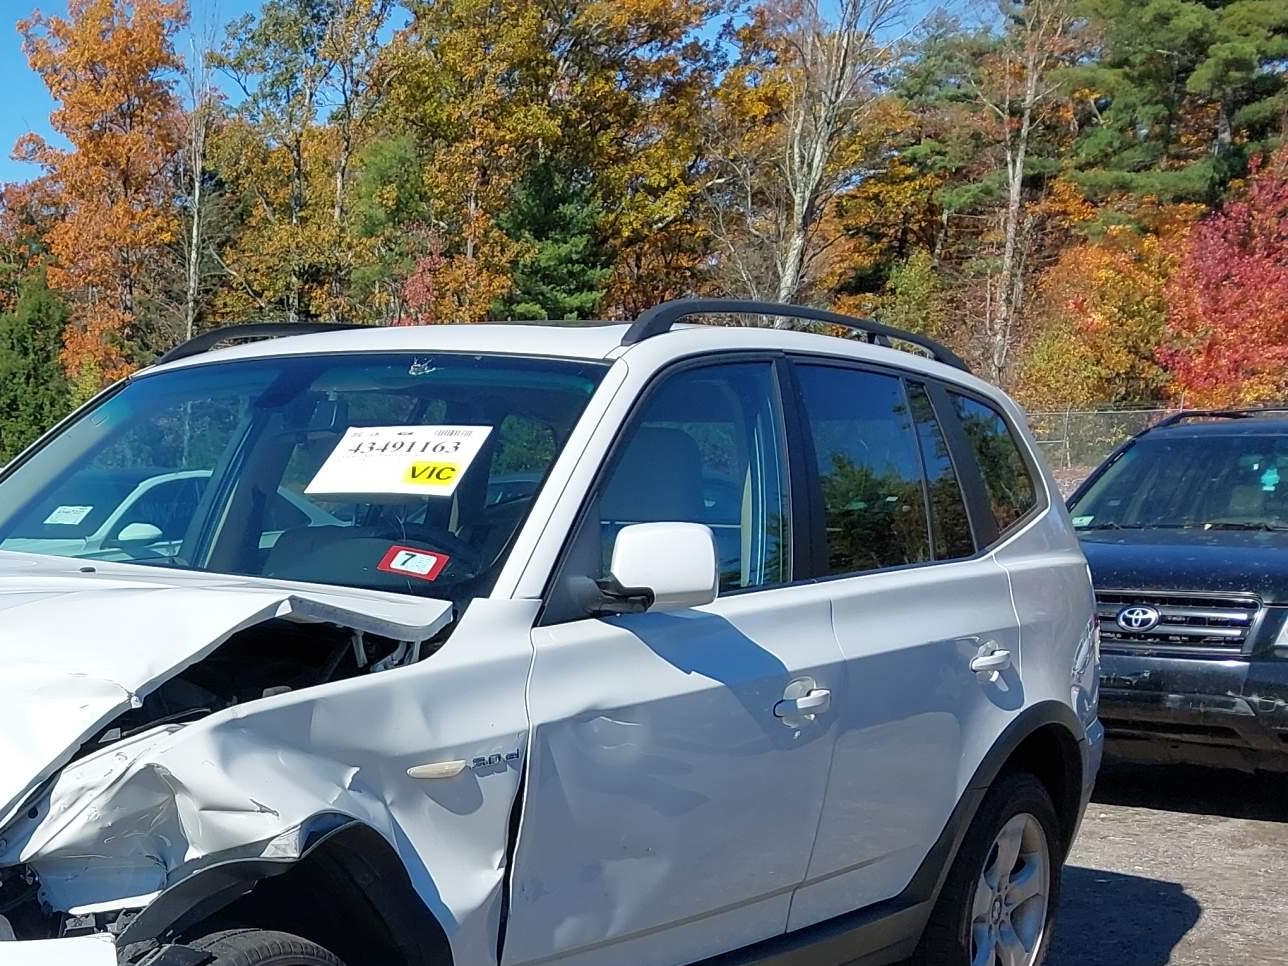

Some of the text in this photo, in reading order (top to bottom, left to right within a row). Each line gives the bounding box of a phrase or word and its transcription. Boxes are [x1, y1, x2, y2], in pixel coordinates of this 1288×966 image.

[348, 440, 462, 454] 43491163
[411, 465, 457, 481] VIC
[400, 552, 417, 567] 7
